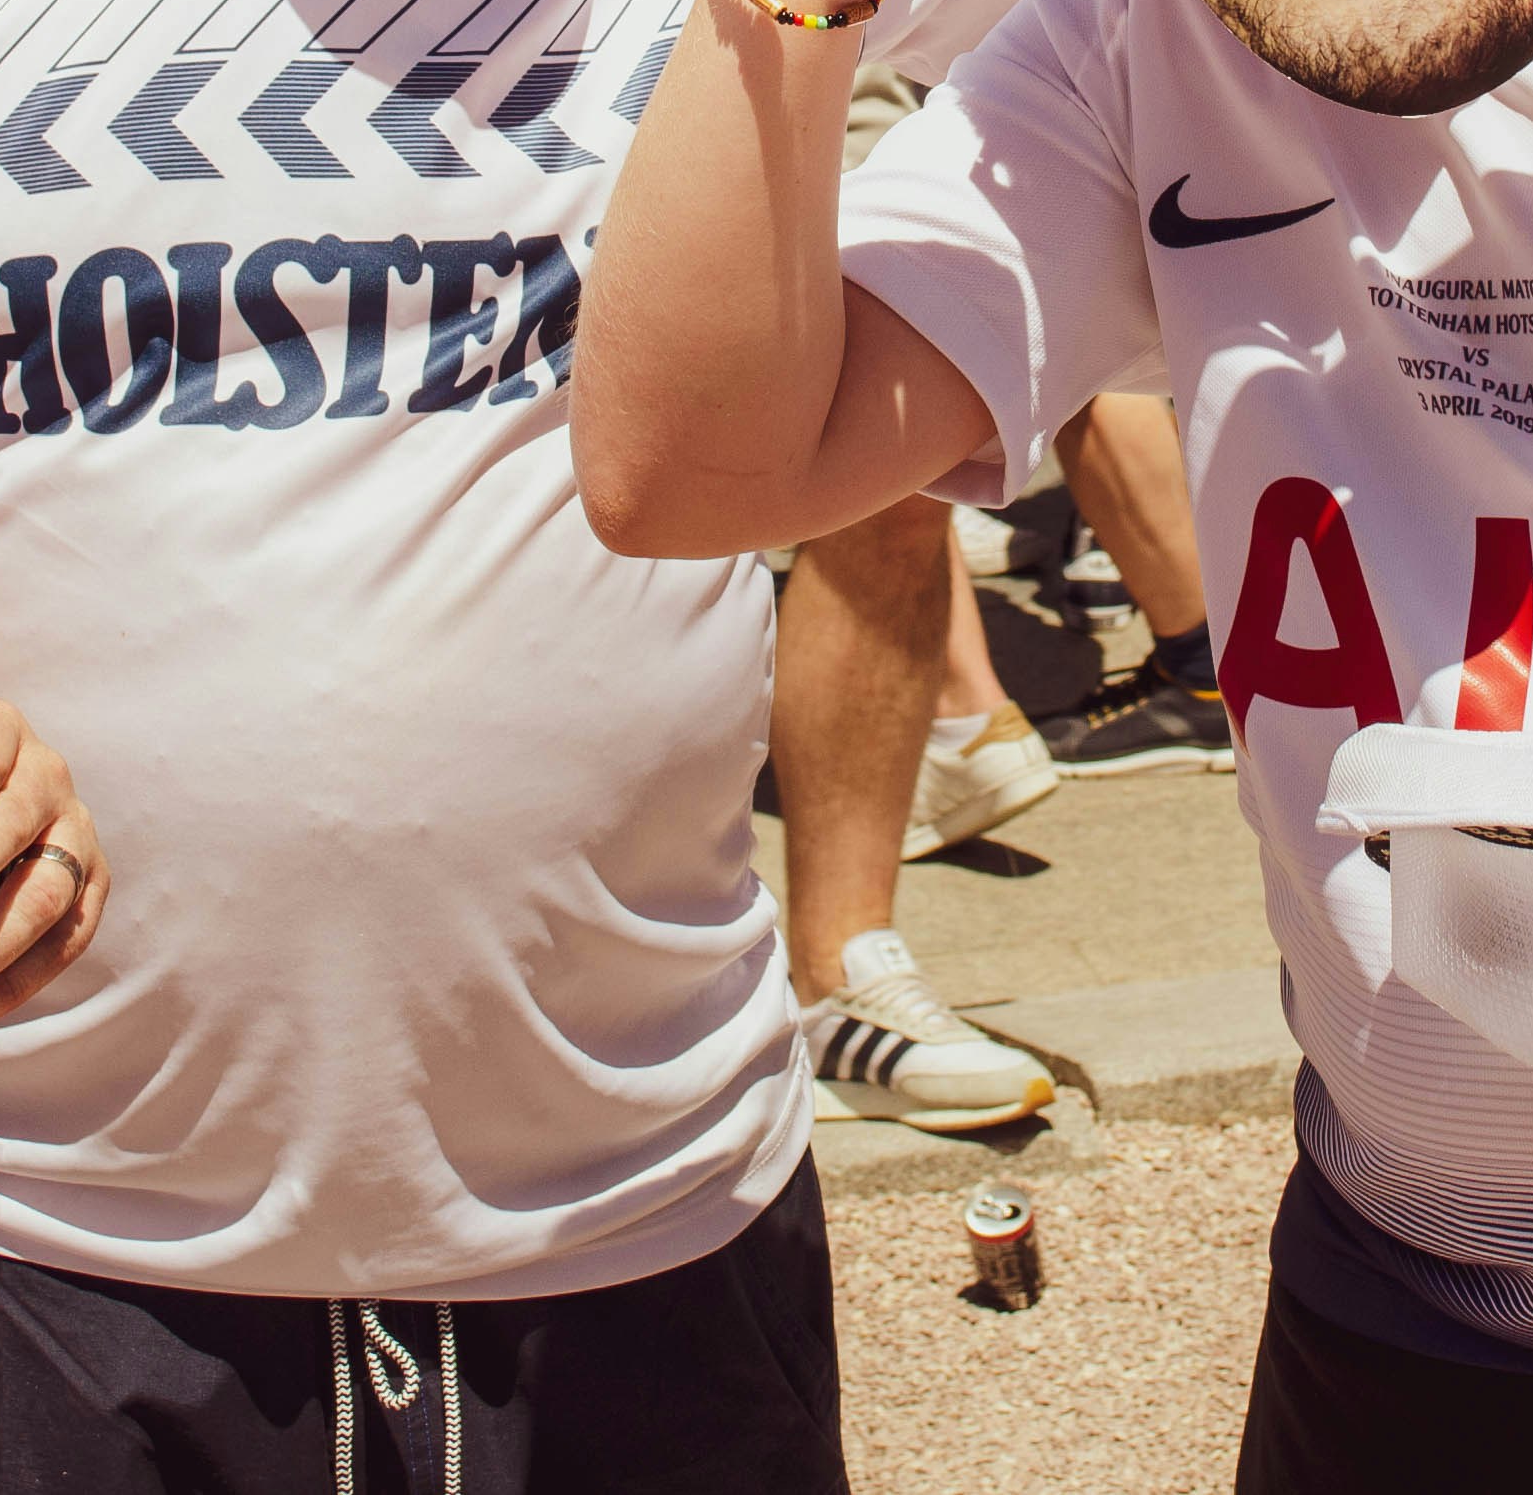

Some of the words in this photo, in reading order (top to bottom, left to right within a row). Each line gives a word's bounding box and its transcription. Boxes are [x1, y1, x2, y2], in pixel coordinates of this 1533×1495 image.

[1385, 268, 1498, 300] INAUGURAL
[1367, 285, 1491, 335] TOTTENHAM
[1397, 356, 1477, 387] CRYSTAL
[1461, 345, 1490, 367] VS
[1417, 391, 1429, 412] 3
[1430, 394, 1485, 417] APRIL
